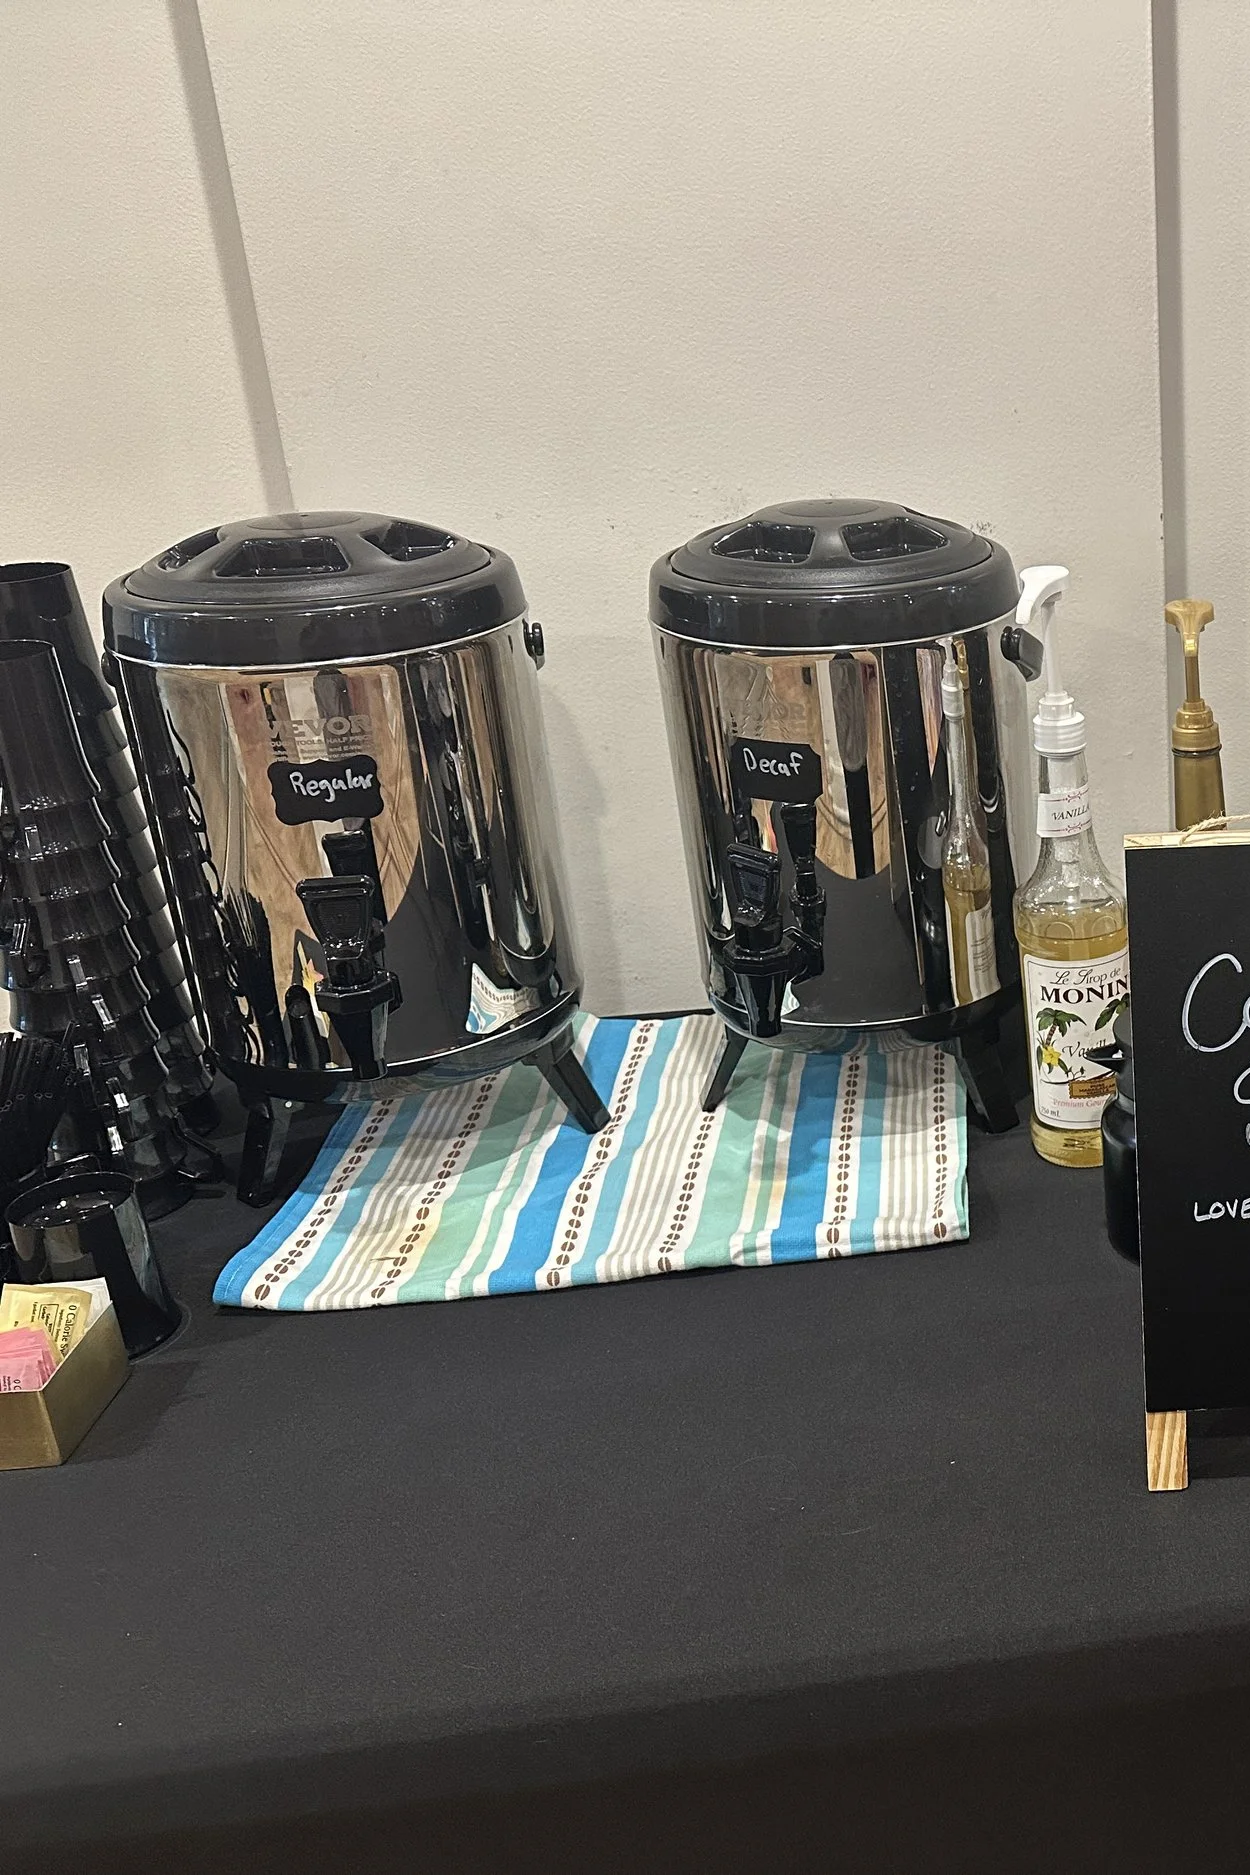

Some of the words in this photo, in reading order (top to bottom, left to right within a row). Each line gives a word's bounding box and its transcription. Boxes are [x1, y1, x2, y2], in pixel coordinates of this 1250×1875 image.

[743, 747, 803, 776] Decaf
[289, 768, 373, 803] Regular
[1040, 974, 1128, 1004] MONIN
[61, 1312, 76, 1342] Calorie
